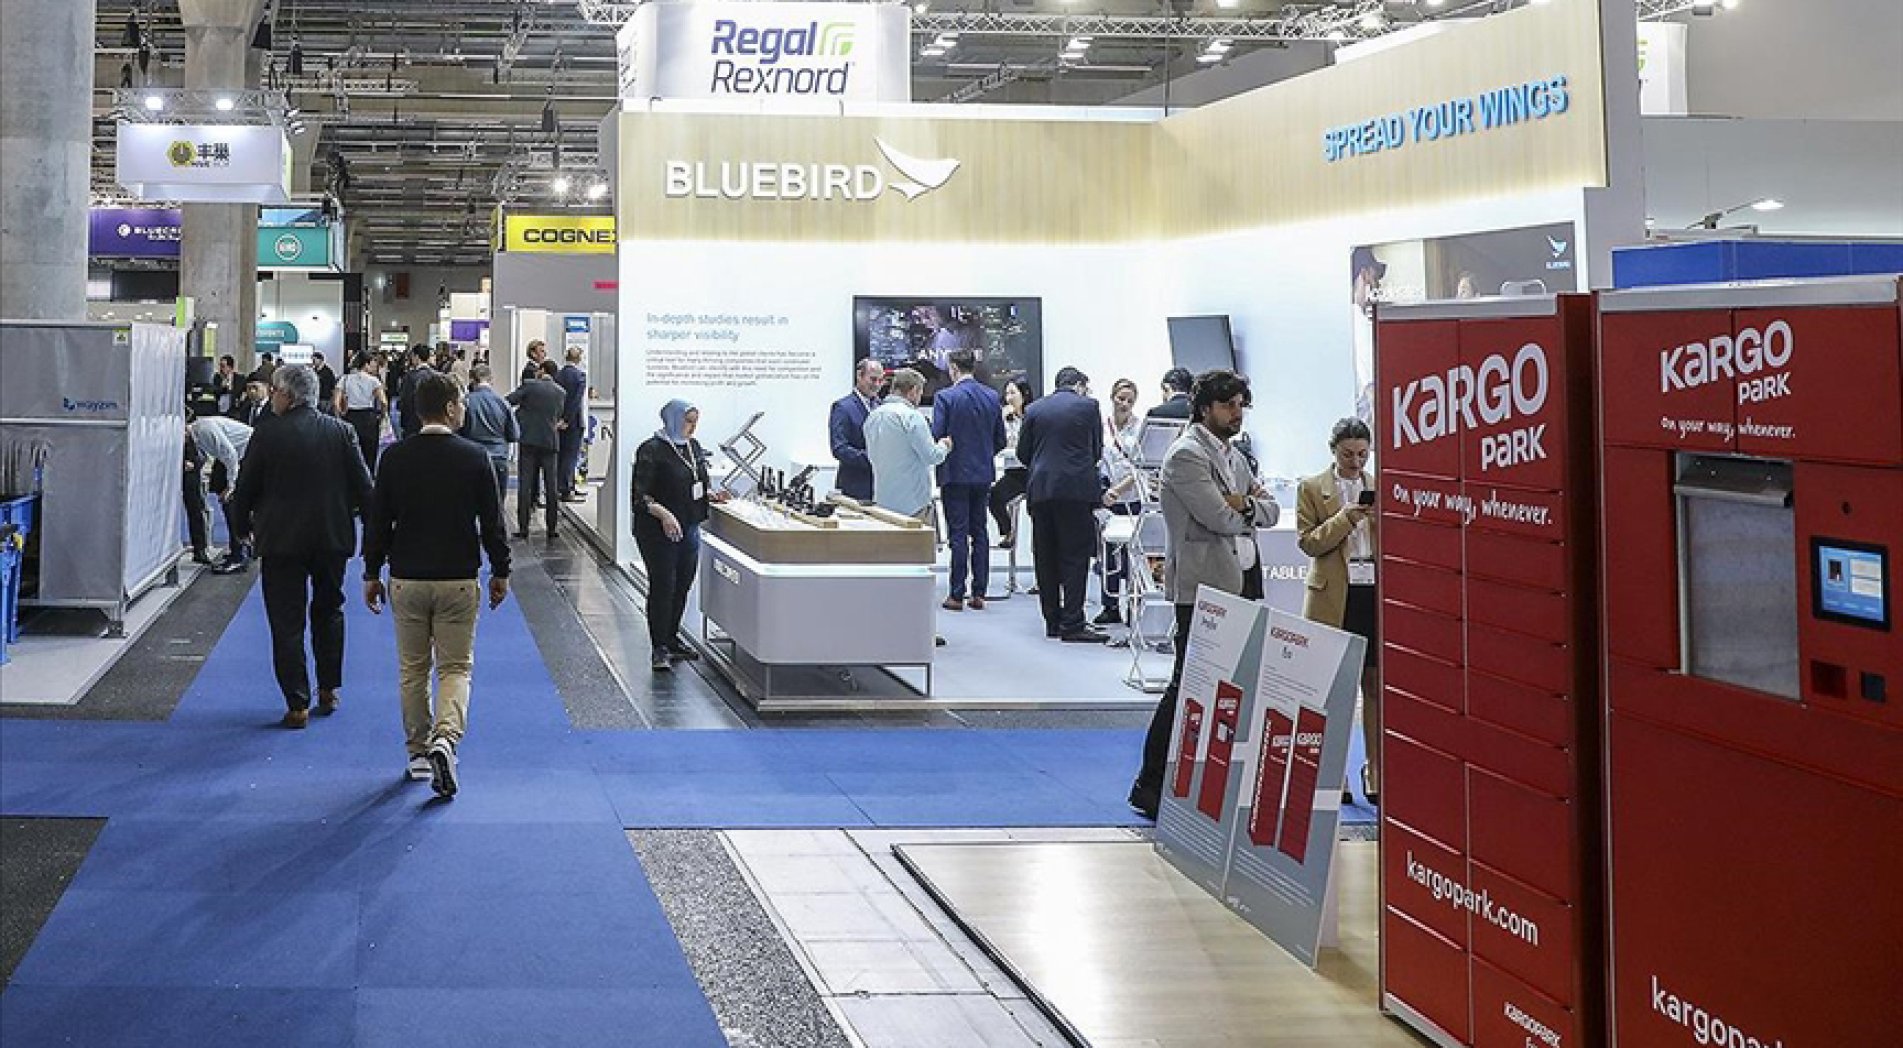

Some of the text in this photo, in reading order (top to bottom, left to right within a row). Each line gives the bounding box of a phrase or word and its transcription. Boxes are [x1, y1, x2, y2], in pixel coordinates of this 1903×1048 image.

[711, 19, 818, 64] Regal
[711, 59, 849, 94] Rexnord
[1322, 73, 1570, 163] SPREAD YOUR WINGS
[665, 160, 884, 201] BLUEBIRD
[646, 329, 741, 344] sharper visibility
[697, 314, 740, 326] studies
[741, 315, 776, 326] result
[1660, 415, 1797, 443] On your way, whenever.
[1393, 483, 1553, 526] On your way, whenever.
[1405, 849, 1540, 946] kargopark.com
